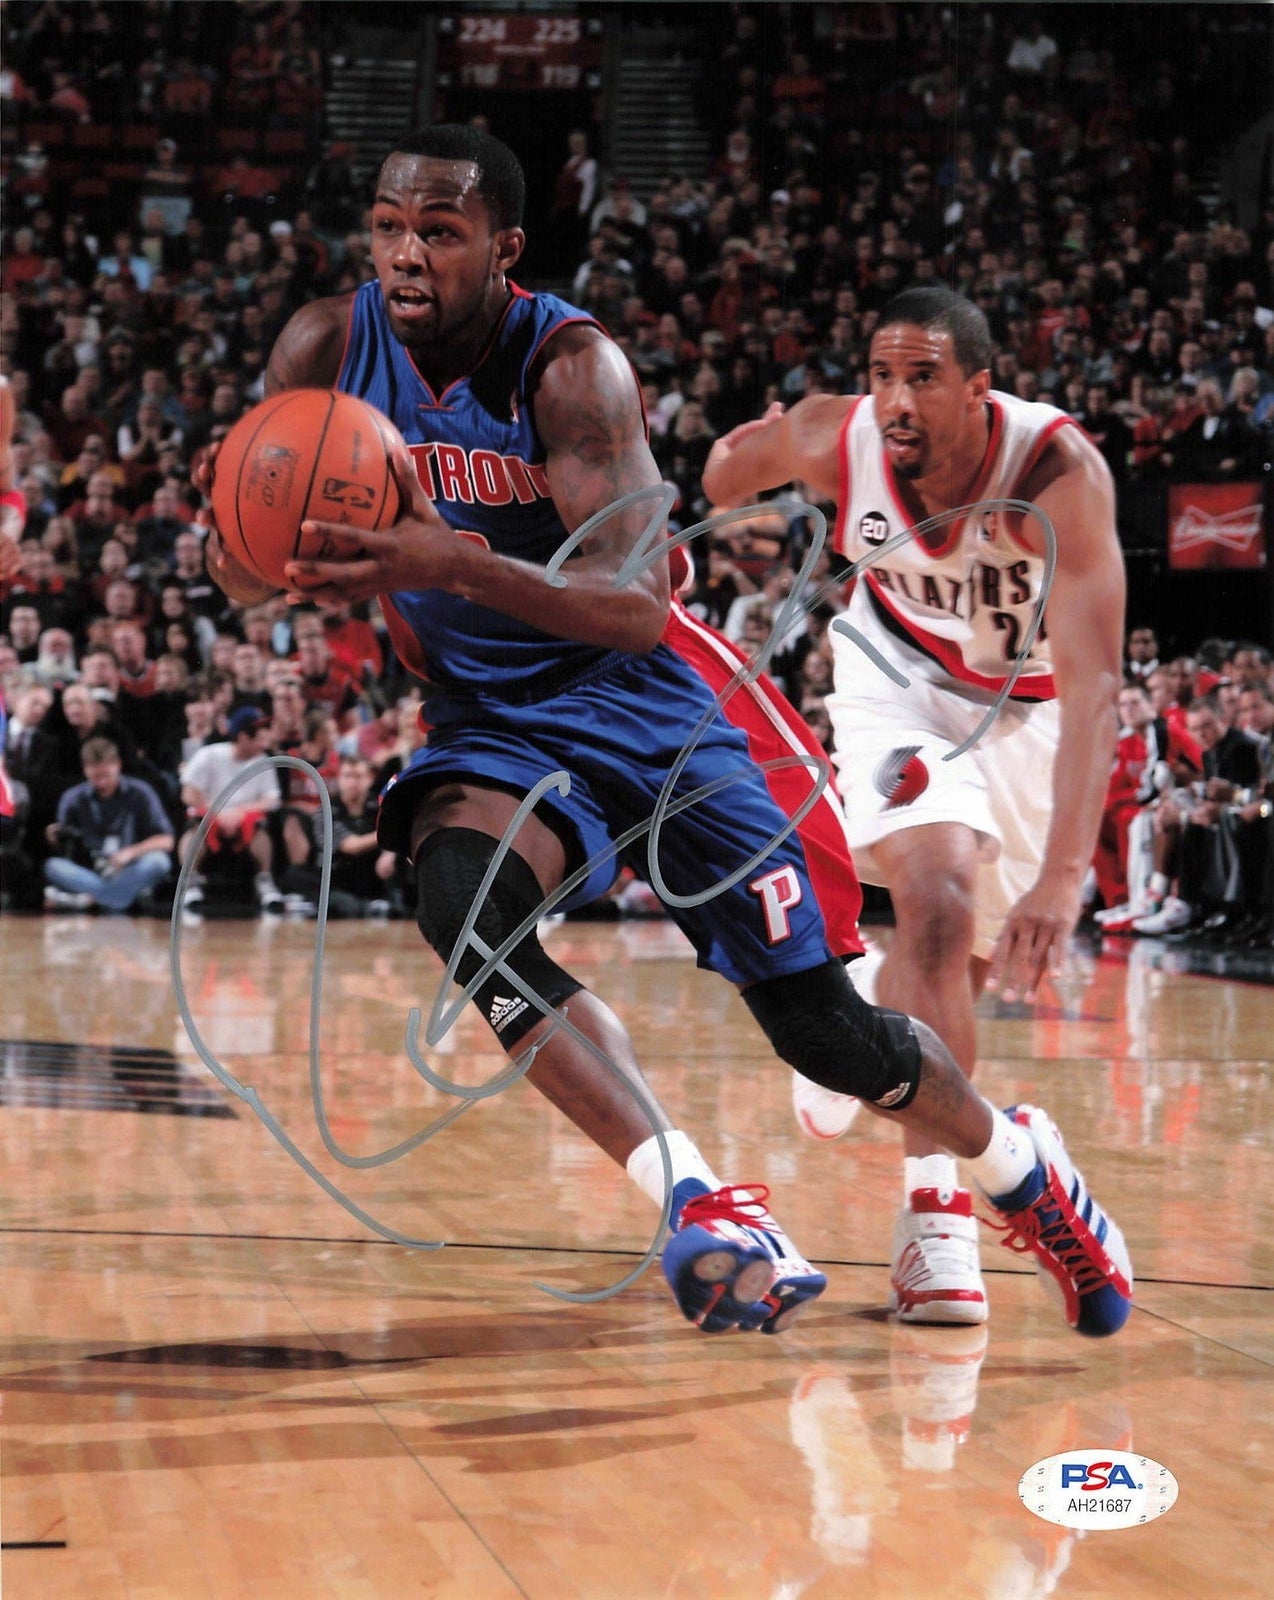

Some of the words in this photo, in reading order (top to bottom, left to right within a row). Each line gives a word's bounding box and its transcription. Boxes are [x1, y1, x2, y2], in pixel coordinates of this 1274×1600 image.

[459, 17, 506, 43] 224
[534, 17, 581, 43] 225
[861, 518, 887, 541] 20
[992, 611, 1048, 661] 2
[748, 864, 802, 945] P
[490, 996, 522, 1027] adidas
